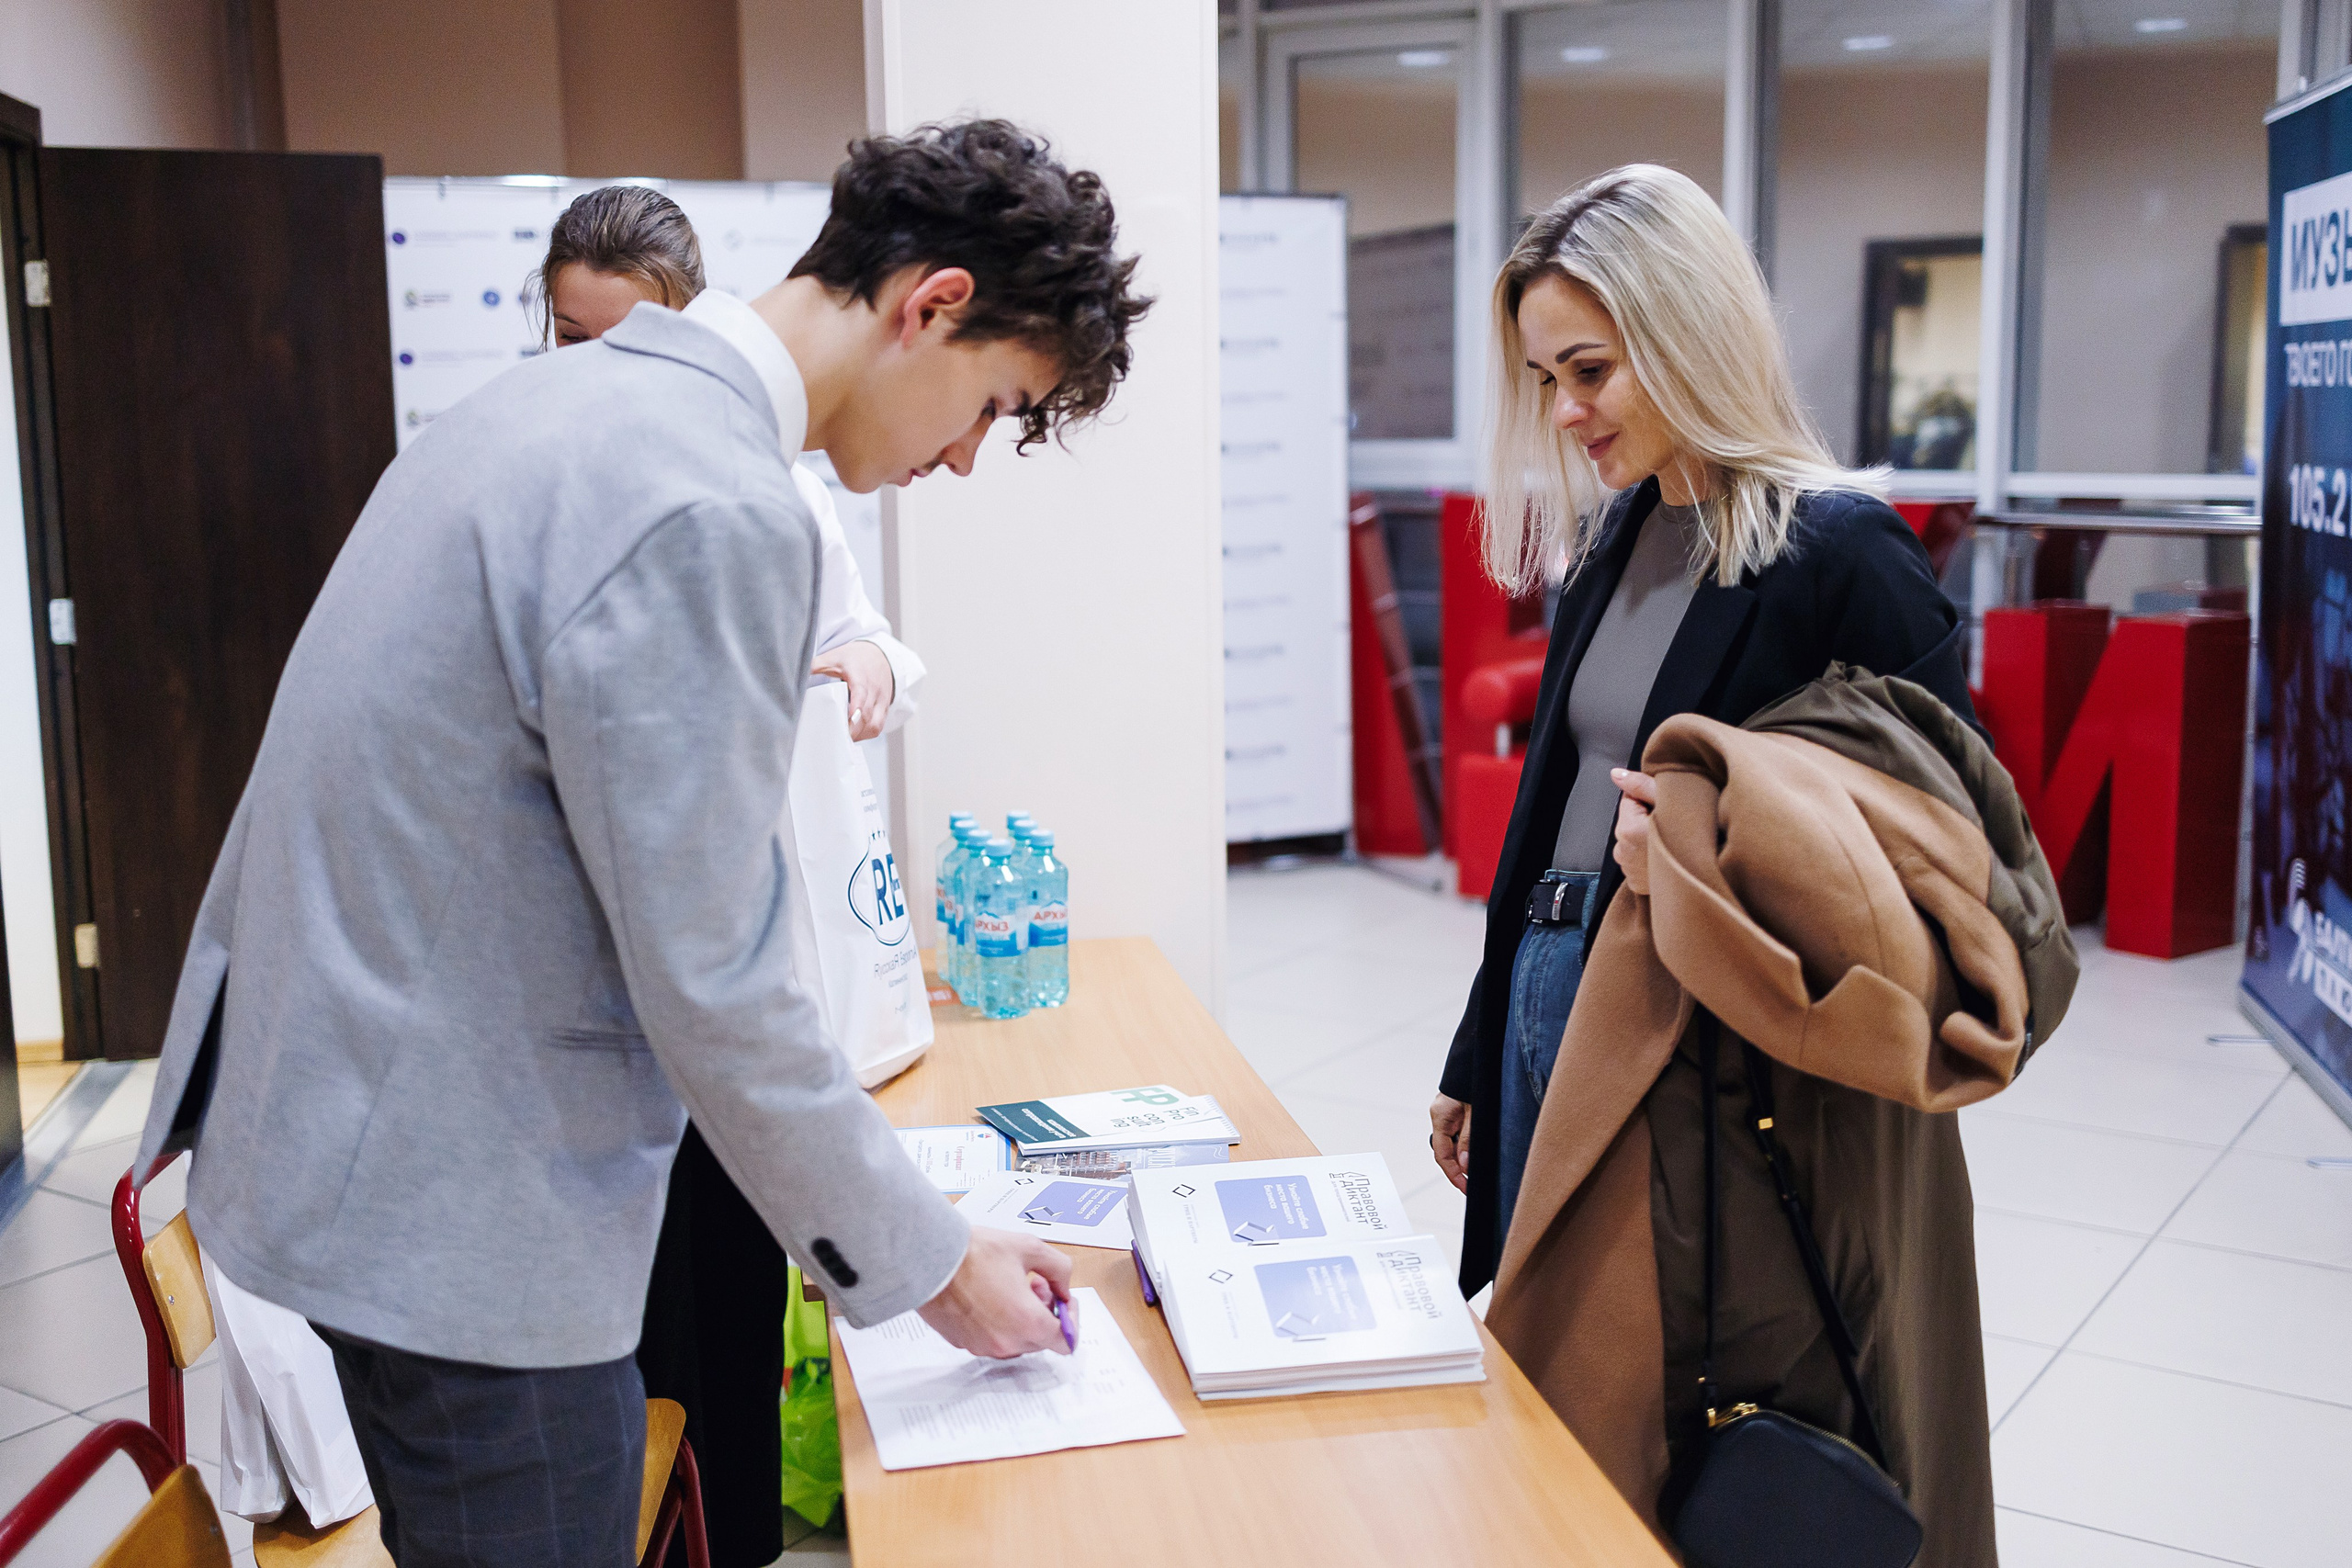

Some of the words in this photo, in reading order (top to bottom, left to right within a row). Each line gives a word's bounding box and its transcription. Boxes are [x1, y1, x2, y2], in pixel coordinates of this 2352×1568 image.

[2289, 463, 2346, 537] 105.2
[1143, 1112, 1166, 1125] con
[1162, 1109, 1185, 1121] Pro
[1179, 1106, 1200, 1117] Fin
[1339, 1179, 1369, 1224] диктант
[1354, 1178, 1388, 1230] Правовой
[1405, 1257, 1443, 1319] Правовой
